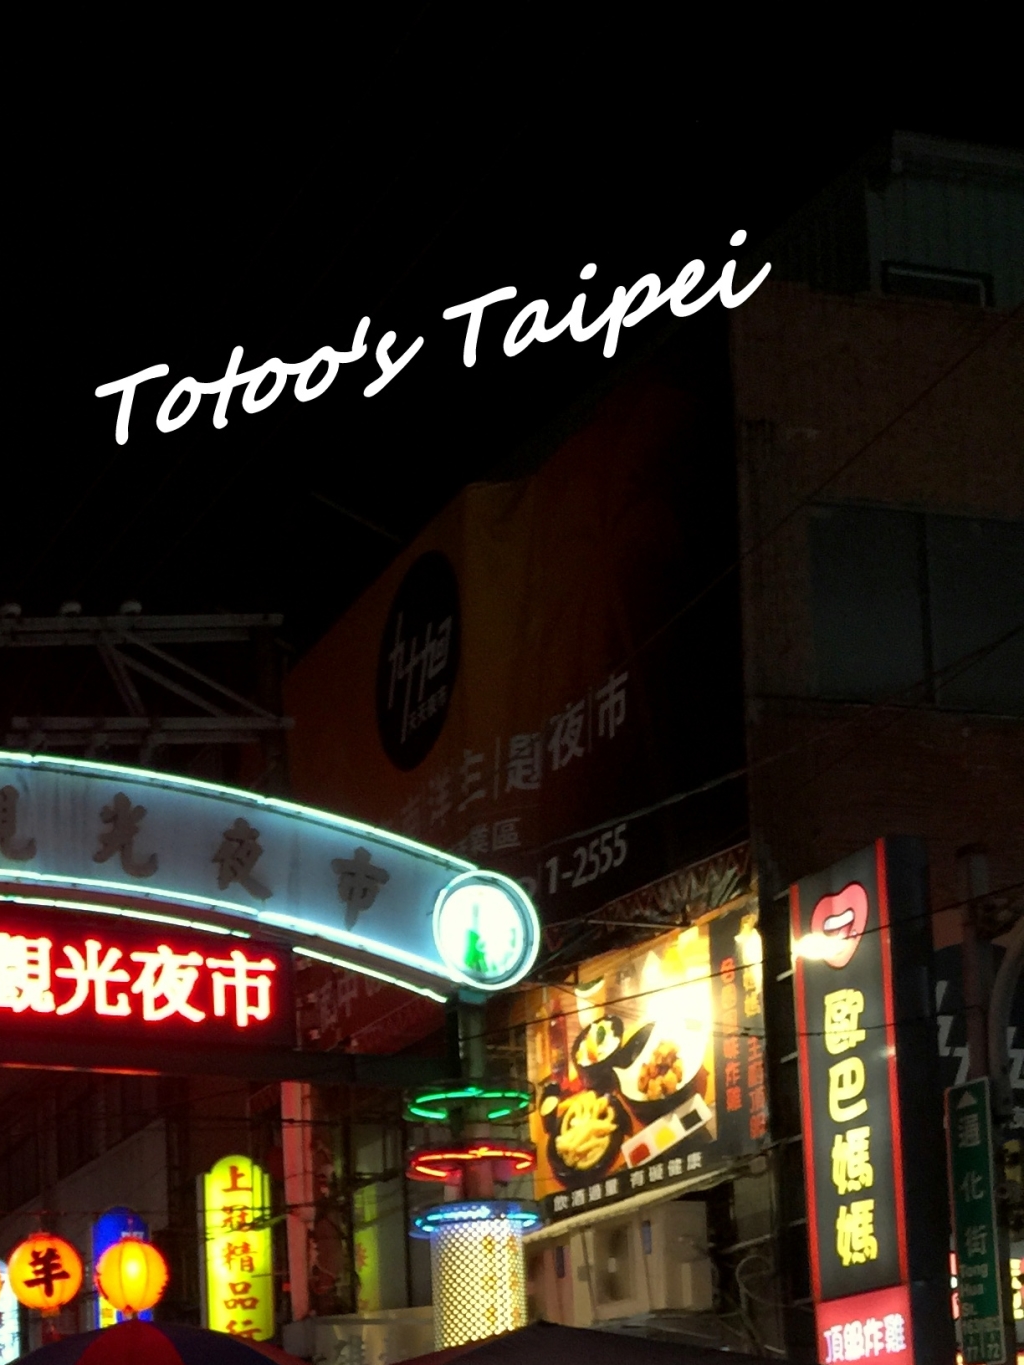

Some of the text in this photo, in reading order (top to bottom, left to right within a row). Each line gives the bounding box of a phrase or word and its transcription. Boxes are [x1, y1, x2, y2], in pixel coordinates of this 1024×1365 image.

[823, 988, 879, 1267] 歐巴媽媽
[957, 1112, 989, 1259] 通化街
[22, 1246, 72, 1299] 羊
